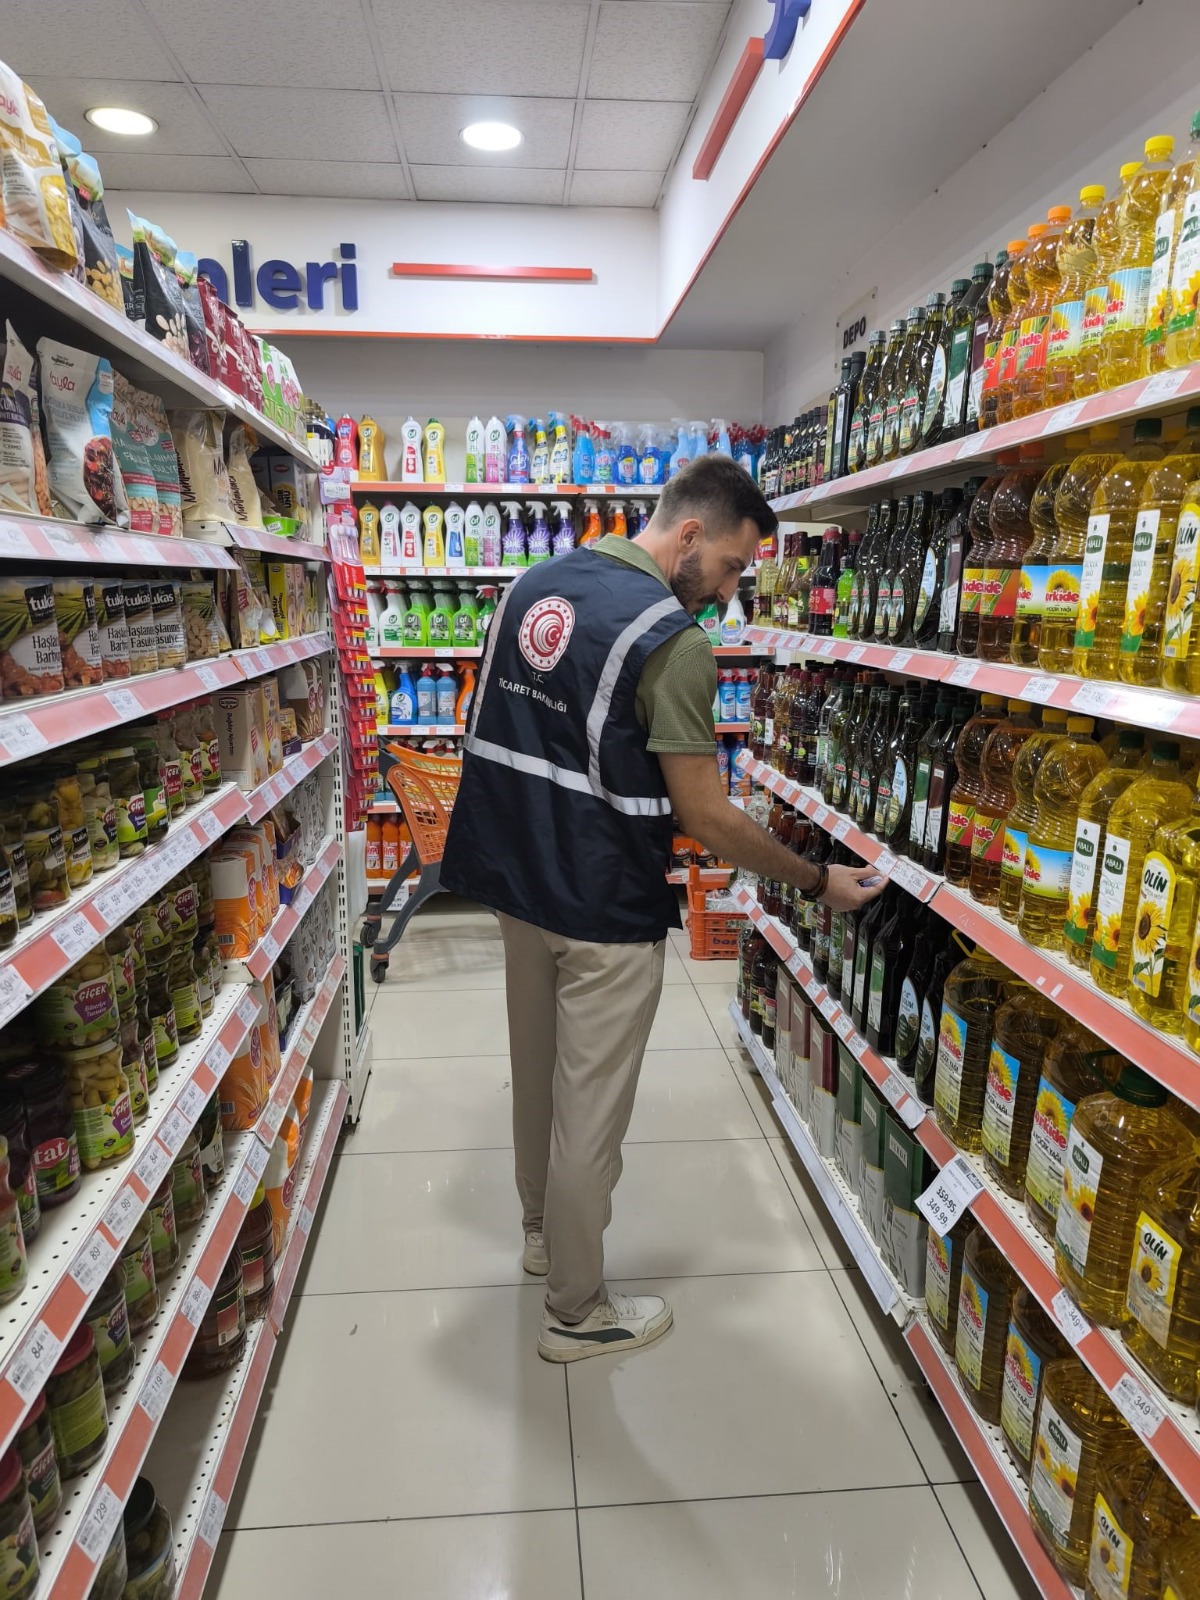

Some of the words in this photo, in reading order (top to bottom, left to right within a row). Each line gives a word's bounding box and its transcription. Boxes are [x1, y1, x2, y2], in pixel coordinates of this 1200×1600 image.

[843, 316, 867, 350] DEPO
[1106, 857, 1122, 870] ABALI
[1144, 869, 1168, 893] OLİN
[79, 983, 107, 1000] ÇİÇEK
[1034, 1109, 1067, 1149] orkide
[34, 1141, 65, 1165] tat
[927, 1198, 948, 1225] 349,99
[1144, 1231, 1168, 1260] OLİN
[1068, 1308, 1081, 1327] 349
[31, 1343, 44, 1359] 84
[1133, 1395, 1151, 1416] 349
[93, 1504, 108, 1524] 129
